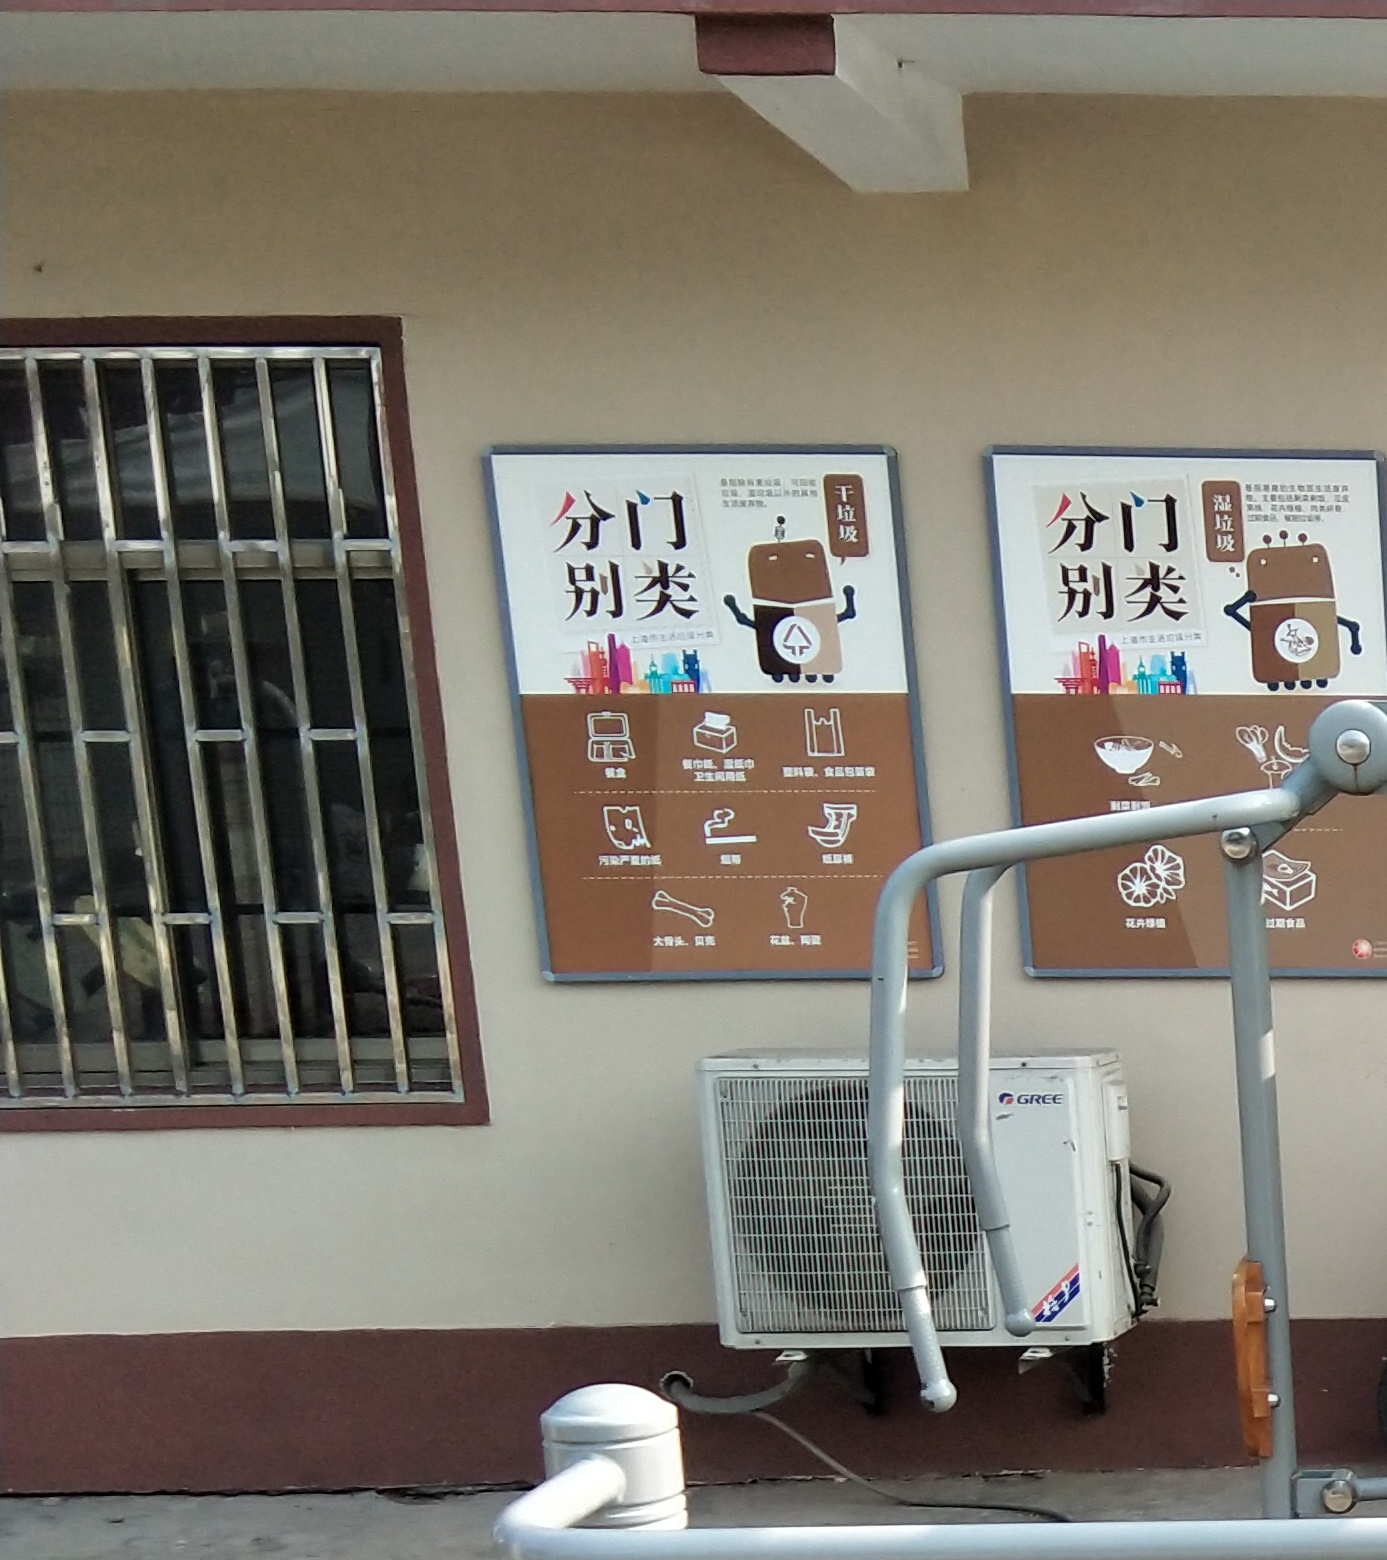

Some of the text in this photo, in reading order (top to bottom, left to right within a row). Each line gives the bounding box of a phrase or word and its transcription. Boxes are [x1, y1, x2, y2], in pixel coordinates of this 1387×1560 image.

[550, 489, 687, 553] 分门
[834, 484, 859, 543] 干垃圾
[1046, 491, 1179, 554] 分门
[1212, 494, 1236, 552] 湿垃圾
[564, 560, 700, 621] 别类
[1058, 561, 1189, 622] 别类
[1016, 1093, 1064, 1106] GREE
